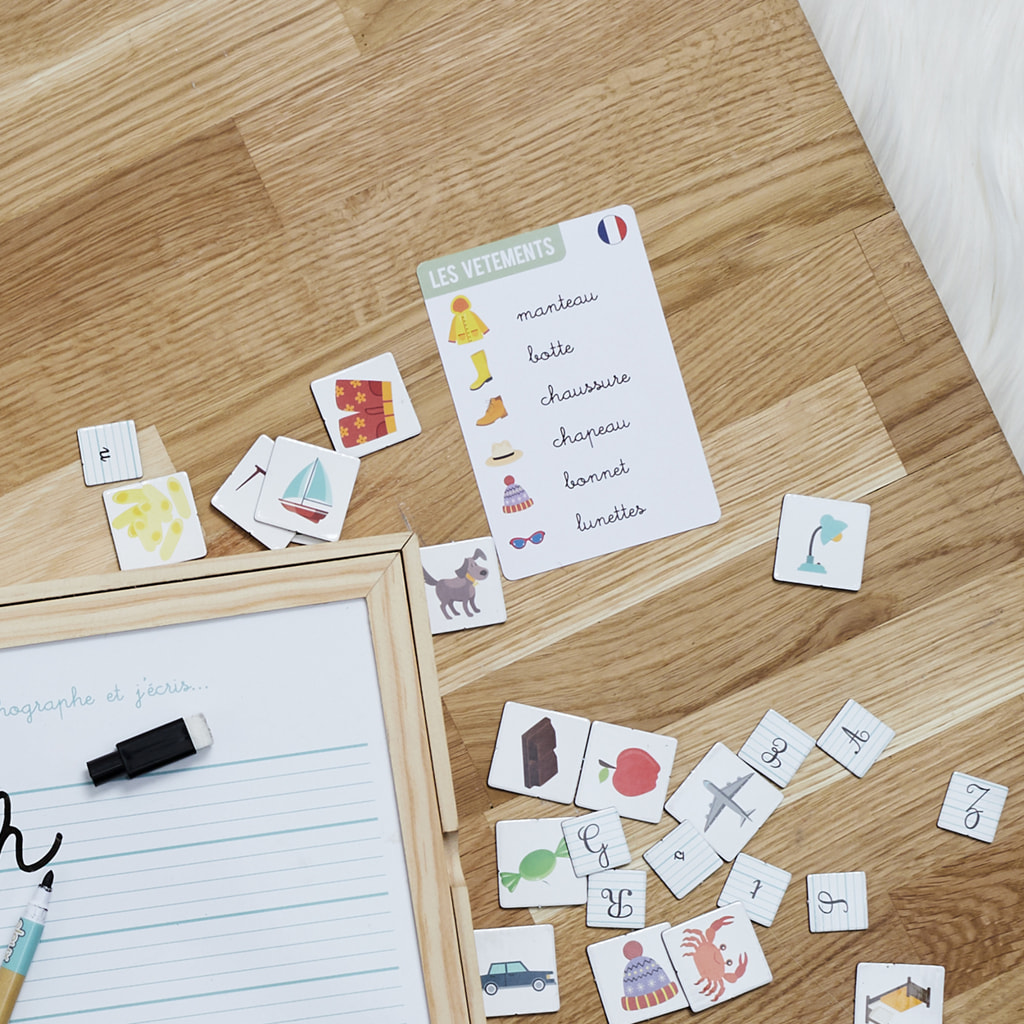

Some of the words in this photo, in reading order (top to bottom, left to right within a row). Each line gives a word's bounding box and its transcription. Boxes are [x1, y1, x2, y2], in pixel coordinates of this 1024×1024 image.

[428, 263, 459, 290] LES
[460, 237, 556, 279] VETEMENTS
[516, 292, 599, 322] manteau
[527, 340, 575, 364] botte
[540, 373, 631, 406] chaussure
[552, 419, 631, 449] chapeau
[563, 458, 630, 490] bonnet
[575, 503, 647, 532] lunettes
[106, 683, 125, 703] et
[841, 726, 870, 755] A
[577, 823, 610, 869] G
[600, 888, 633, 919] R
